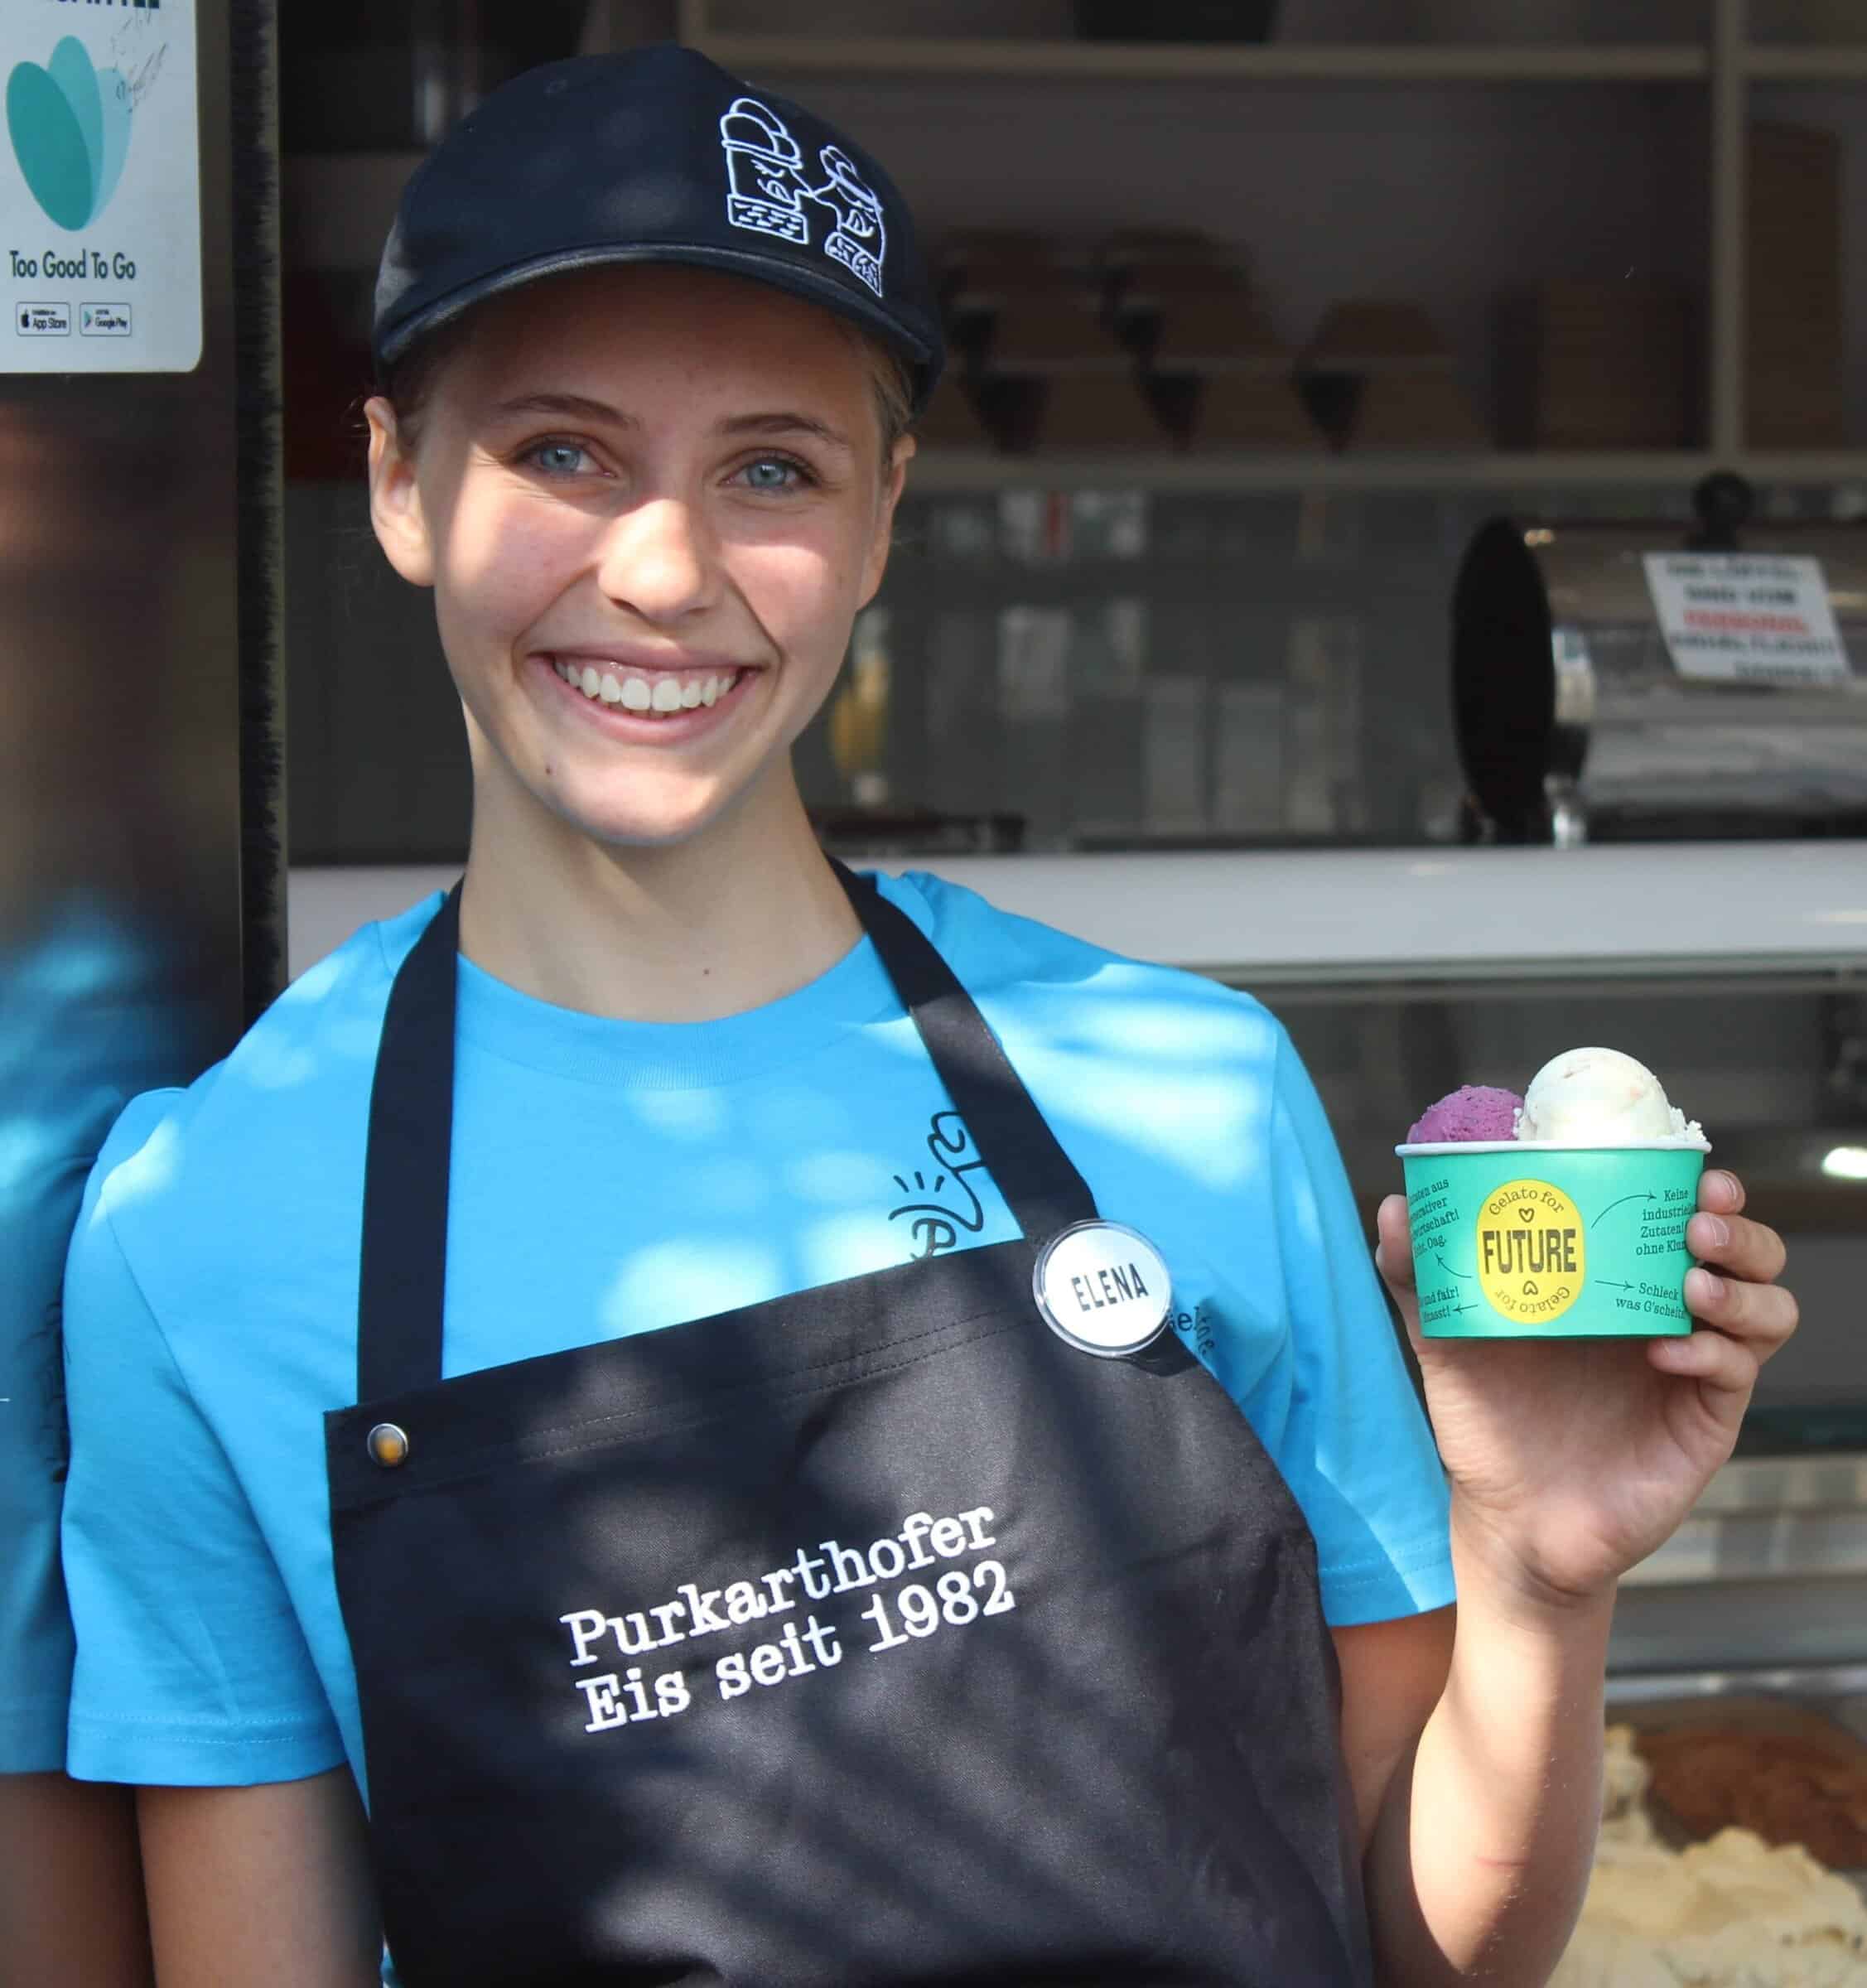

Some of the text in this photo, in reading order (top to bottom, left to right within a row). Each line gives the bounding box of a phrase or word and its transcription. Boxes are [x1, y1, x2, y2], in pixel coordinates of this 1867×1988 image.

[9, 248, 137, 280] Too Good To Go
[32, 318, 67, 330] App Store
[95, 317, 128, 330] Google Play
[1431, 1179, 1450, 1193] aus
[1488, 1186, 1565, 1216] Gelato for
[1663, 1188, 1689, 1203] Keine
[1643, 1204, 1691, 1222] industrie
[1482, 1228, 1577, 1275] FUTURE
[1636, 1242, 1664, 1256] ohne
[1070, 1262, 1150, 1312] ELENA
[1436, 1285, 1459, 1302] fair!
[1638, 1281, 1679, 1300] Schleck
[1519, 1286, 1570, 1314] Gelato
[1615, 1297, 1641, 1311] was
[558, 1505, 996, 1667] Purkarthofer
[575, 1559, 1016, 1733] Eis seit 1982
